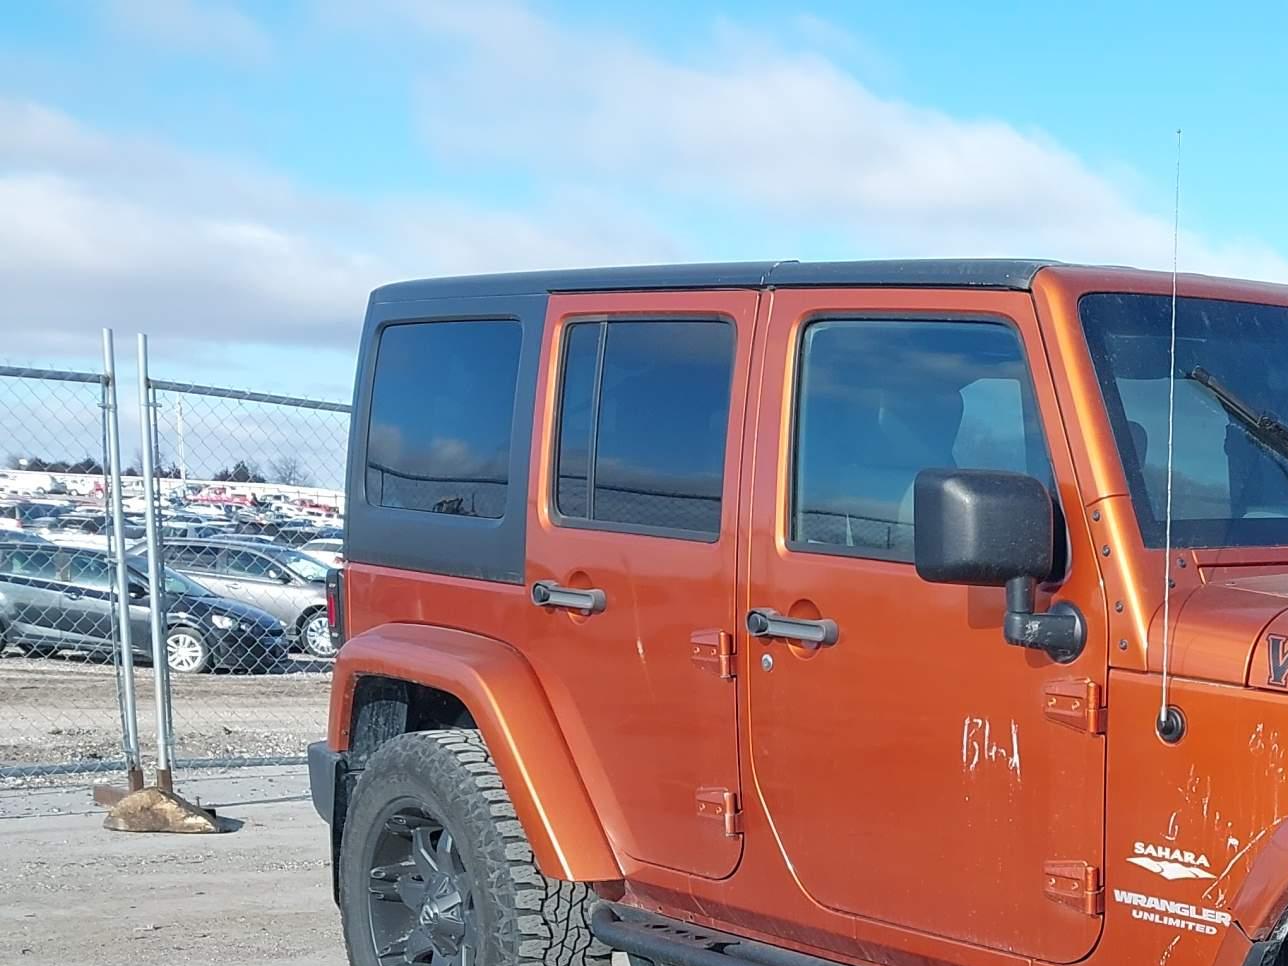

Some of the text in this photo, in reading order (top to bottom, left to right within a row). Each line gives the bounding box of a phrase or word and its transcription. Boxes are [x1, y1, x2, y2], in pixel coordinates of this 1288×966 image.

[1133, 841, 1211, 869] SAHARA
[1113, 889, 1232, 928] WRANGLER
[1131, 908, 1218, 935] UNLIMITED
